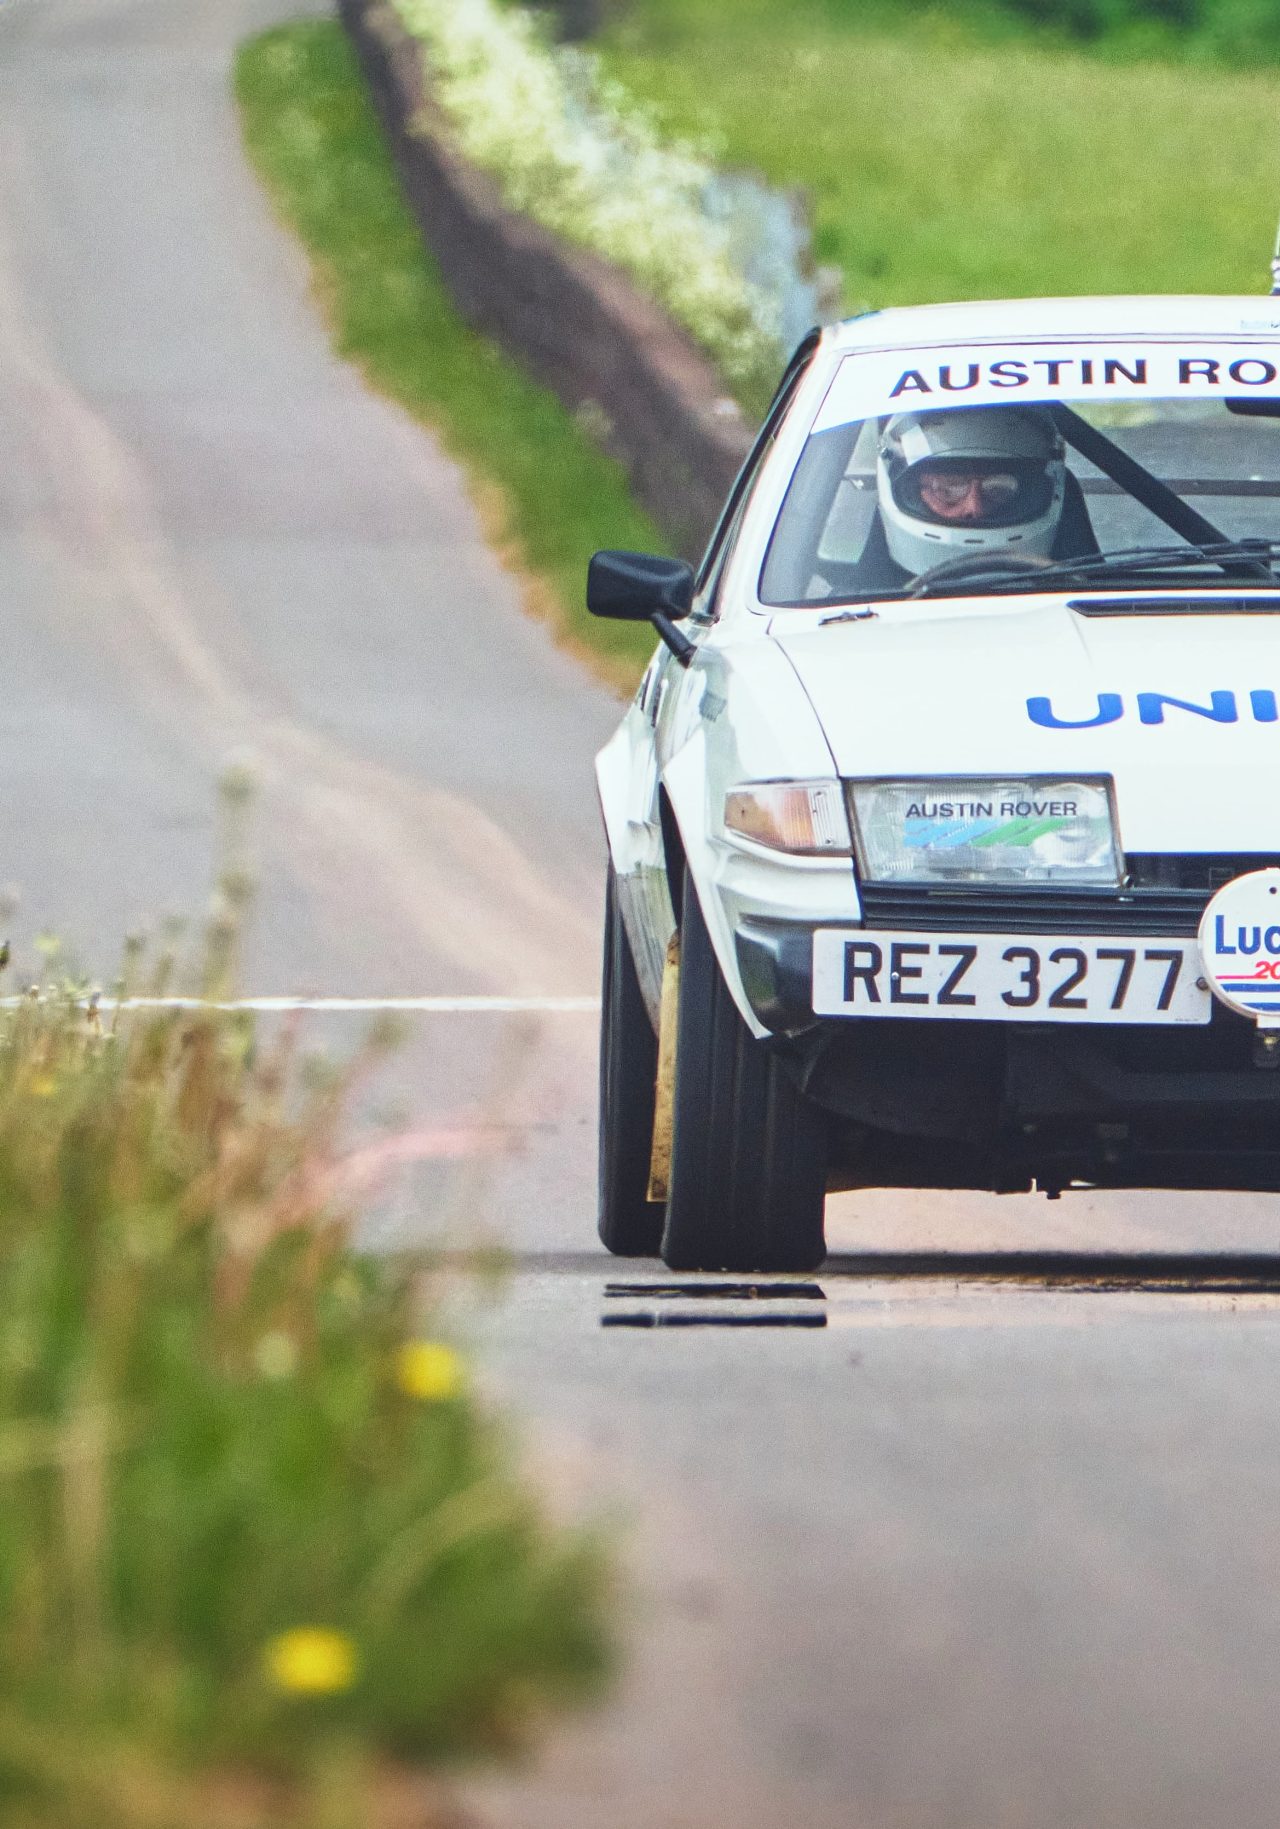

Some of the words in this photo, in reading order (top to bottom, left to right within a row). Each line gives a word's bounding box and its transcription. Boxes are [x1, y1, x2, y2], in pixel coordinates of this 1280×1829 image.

[889, 359, 1148, 398] AUSTIN
[906, 802, 993, 818] AUSTIN
[1001, 802, 1078, 817] ROVER
[843, 941, 978, 1006] REZ
[1001, 947, 1184, 1011] 3277
